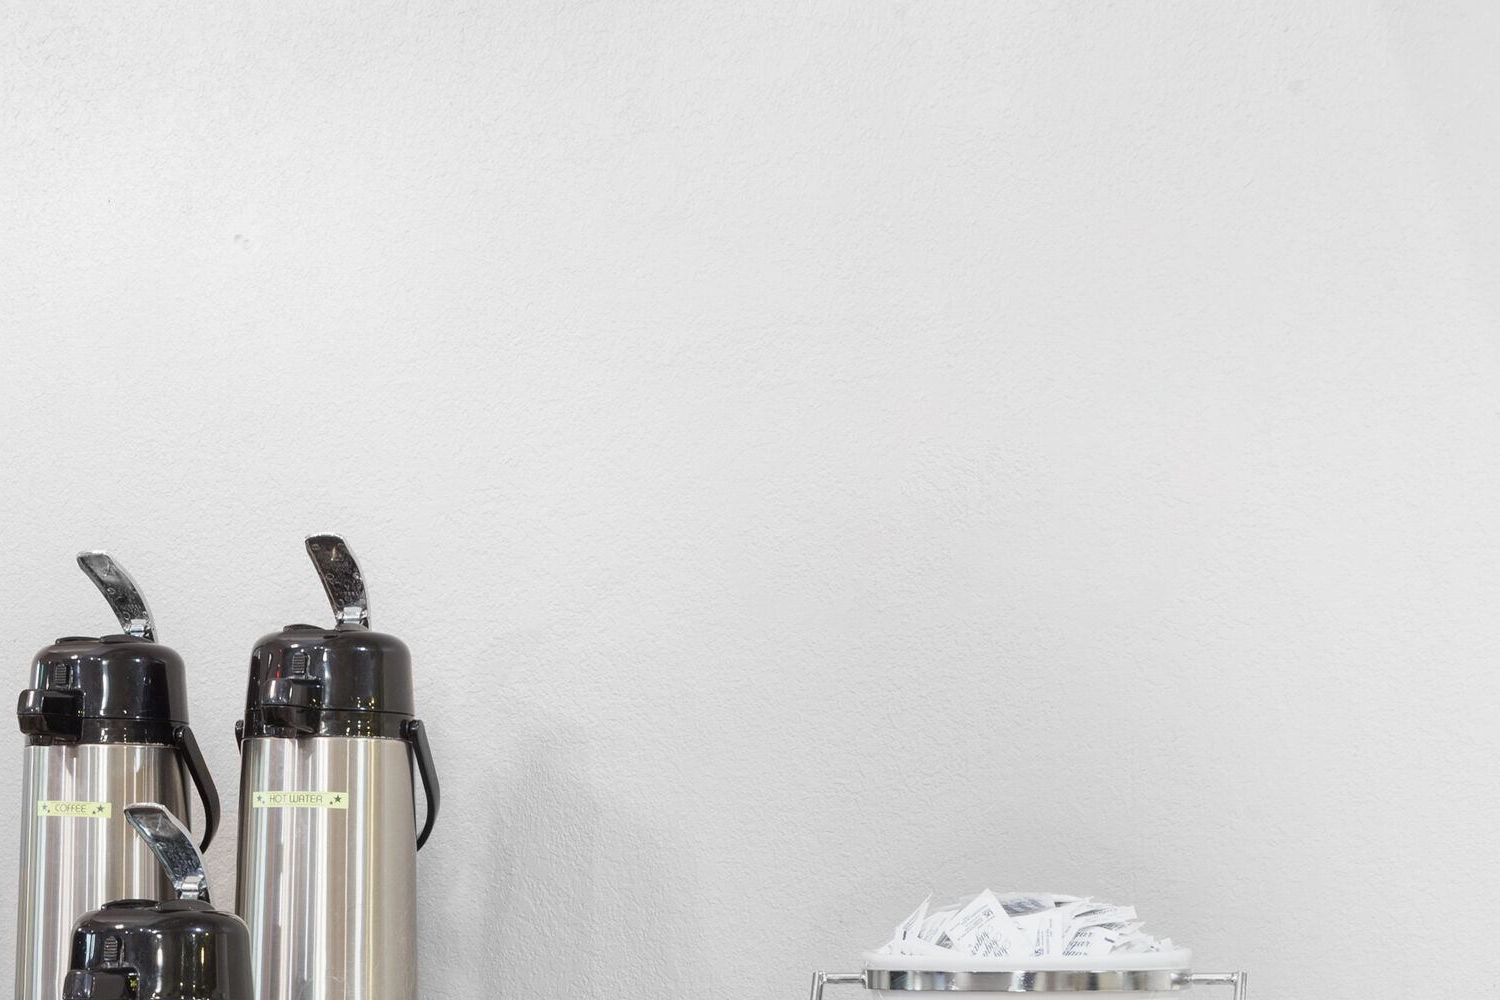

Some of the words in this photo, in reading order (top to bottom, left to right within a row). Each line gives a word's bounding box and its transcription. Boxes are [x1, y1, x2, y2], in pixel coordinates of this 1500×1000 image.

[269, 795, 287, 803] HOT
[289, 795, 323, 803] WATER
[55, 804, 86, 812] COFFEE
